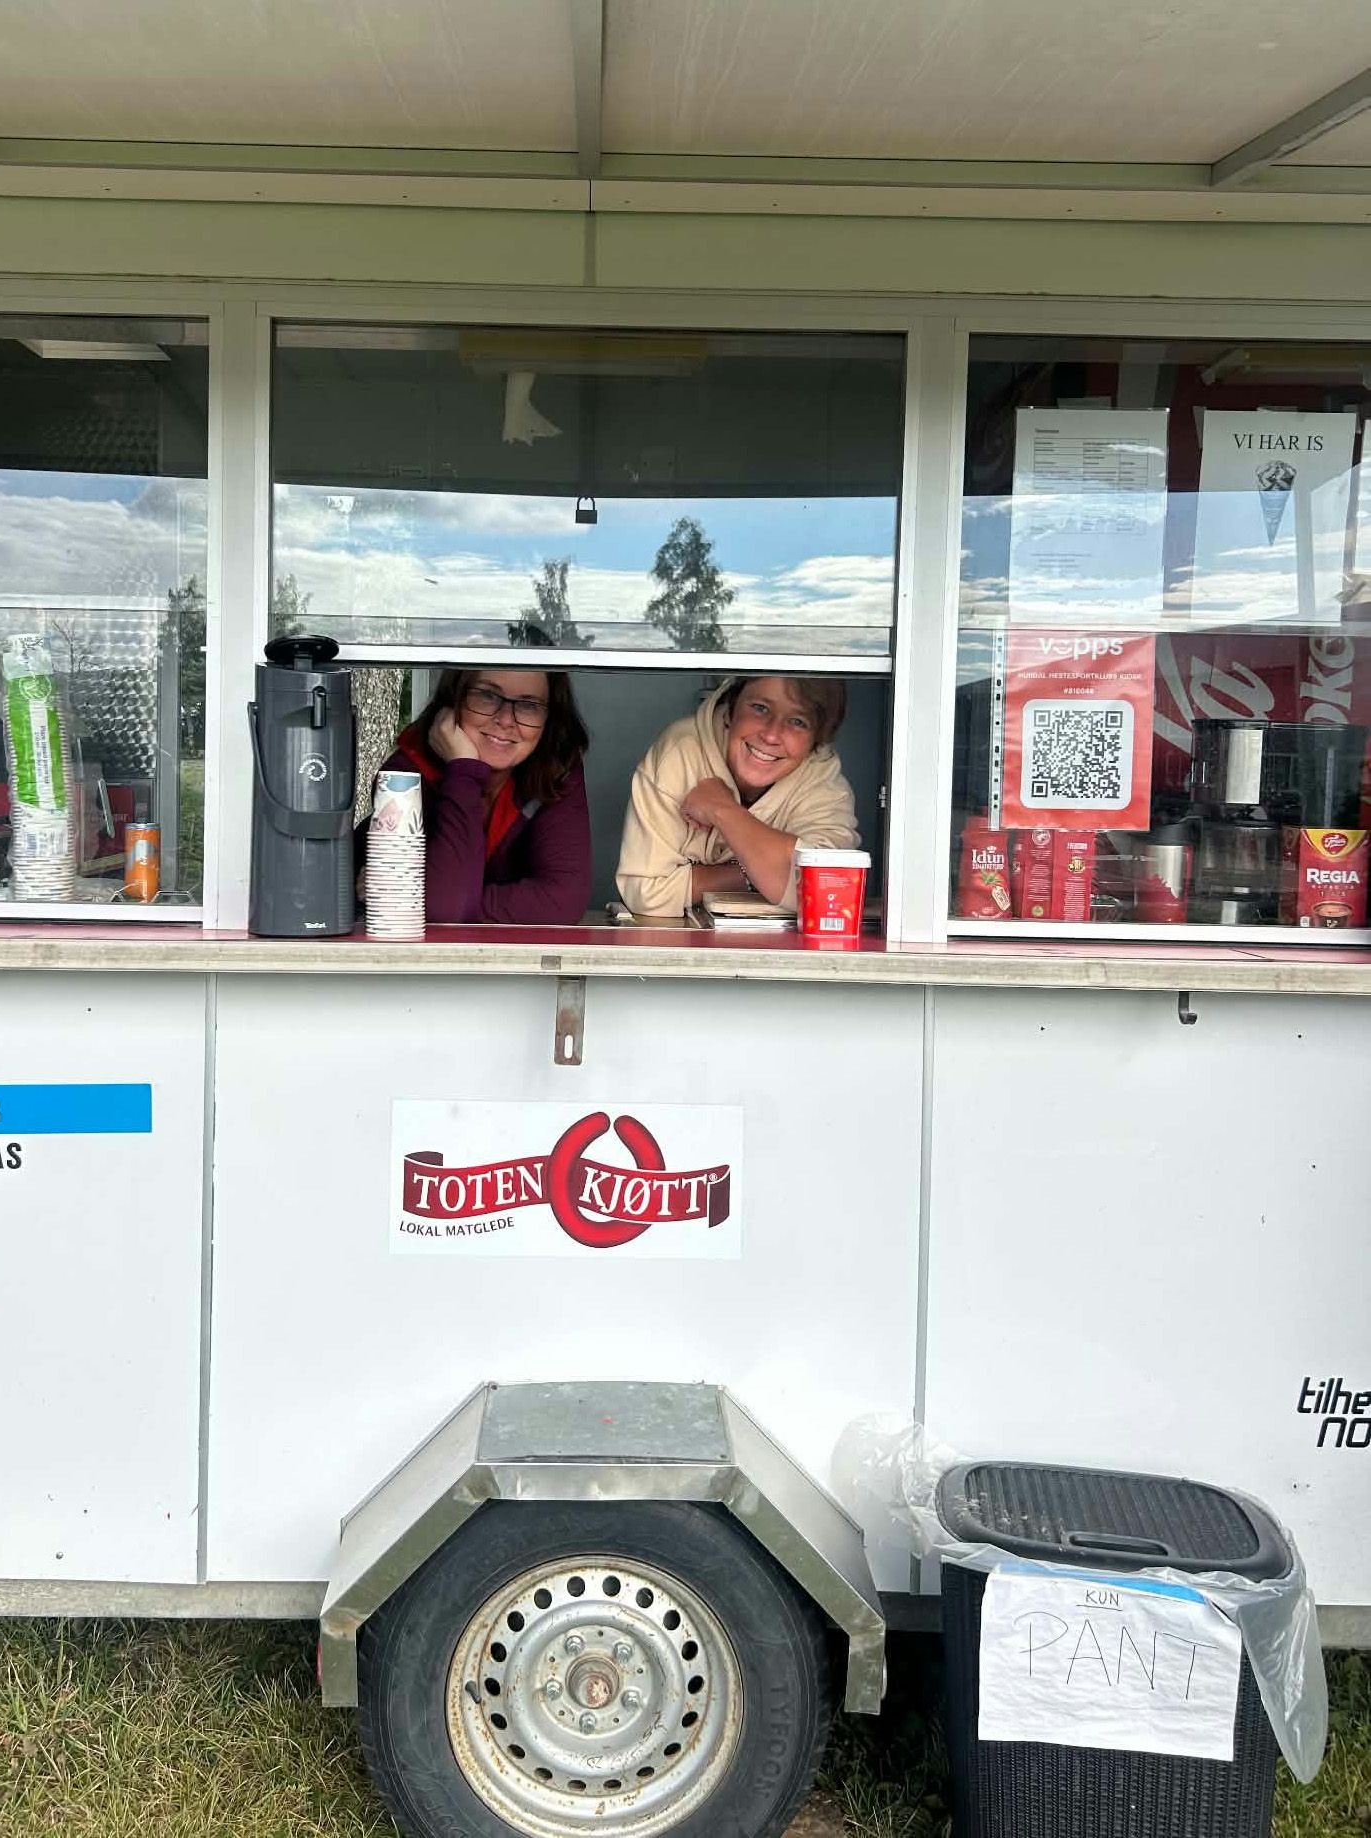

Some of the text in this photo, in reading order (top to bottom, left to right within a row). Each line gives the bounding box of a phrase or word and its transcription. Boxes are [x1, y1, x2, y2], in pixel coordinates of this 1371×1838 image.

[1232, 433, 1324, 452] VI HAR IS
[972, 849, 1005, 864] Idun
[1306, 868, 1360, 884] REGIA
[412, 1163, 708, 1217] TOTEN KJØTT
[399, 1216, 515, 1237] LOKAL MATGLEDE
[1316, 1416, 1371, 1448] no
[1084, 1589, 1119, 1607] KUN
[1013, 1611, 1220, 1701] PANT
